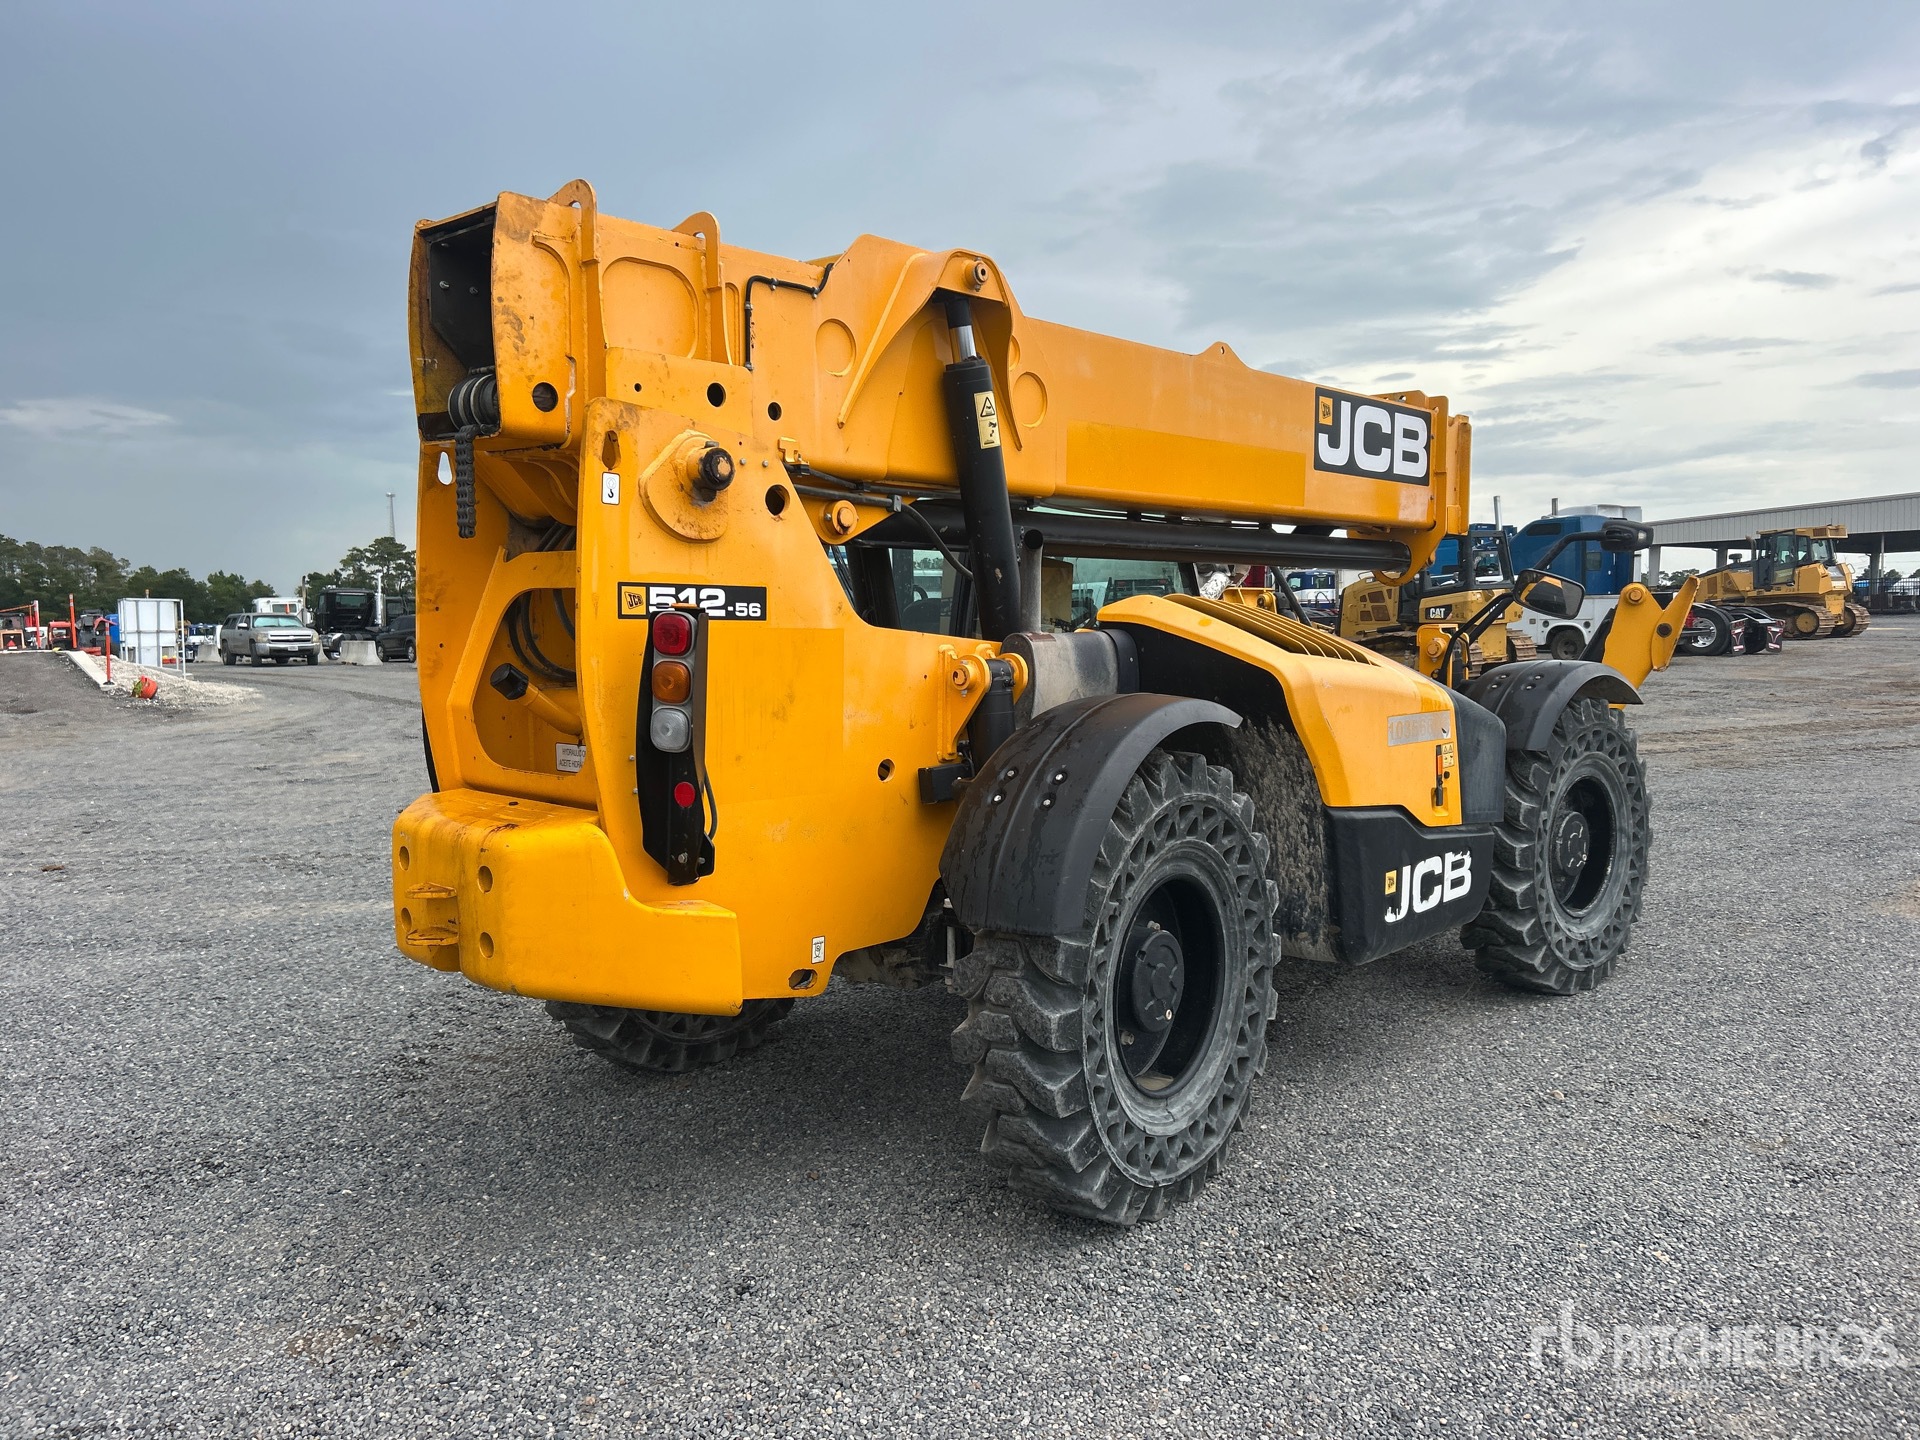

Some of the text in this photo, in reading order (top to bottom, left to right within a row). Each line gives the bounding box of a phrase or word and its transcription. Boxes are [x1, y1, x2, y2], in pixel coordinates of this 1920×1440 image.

[1318, 400, 1428, 478] JCB
[649, 586, 761, 617] 512-56
[1429, 607, 1446, 619] CAT
[1384, 850, 1472, 923] JCB
